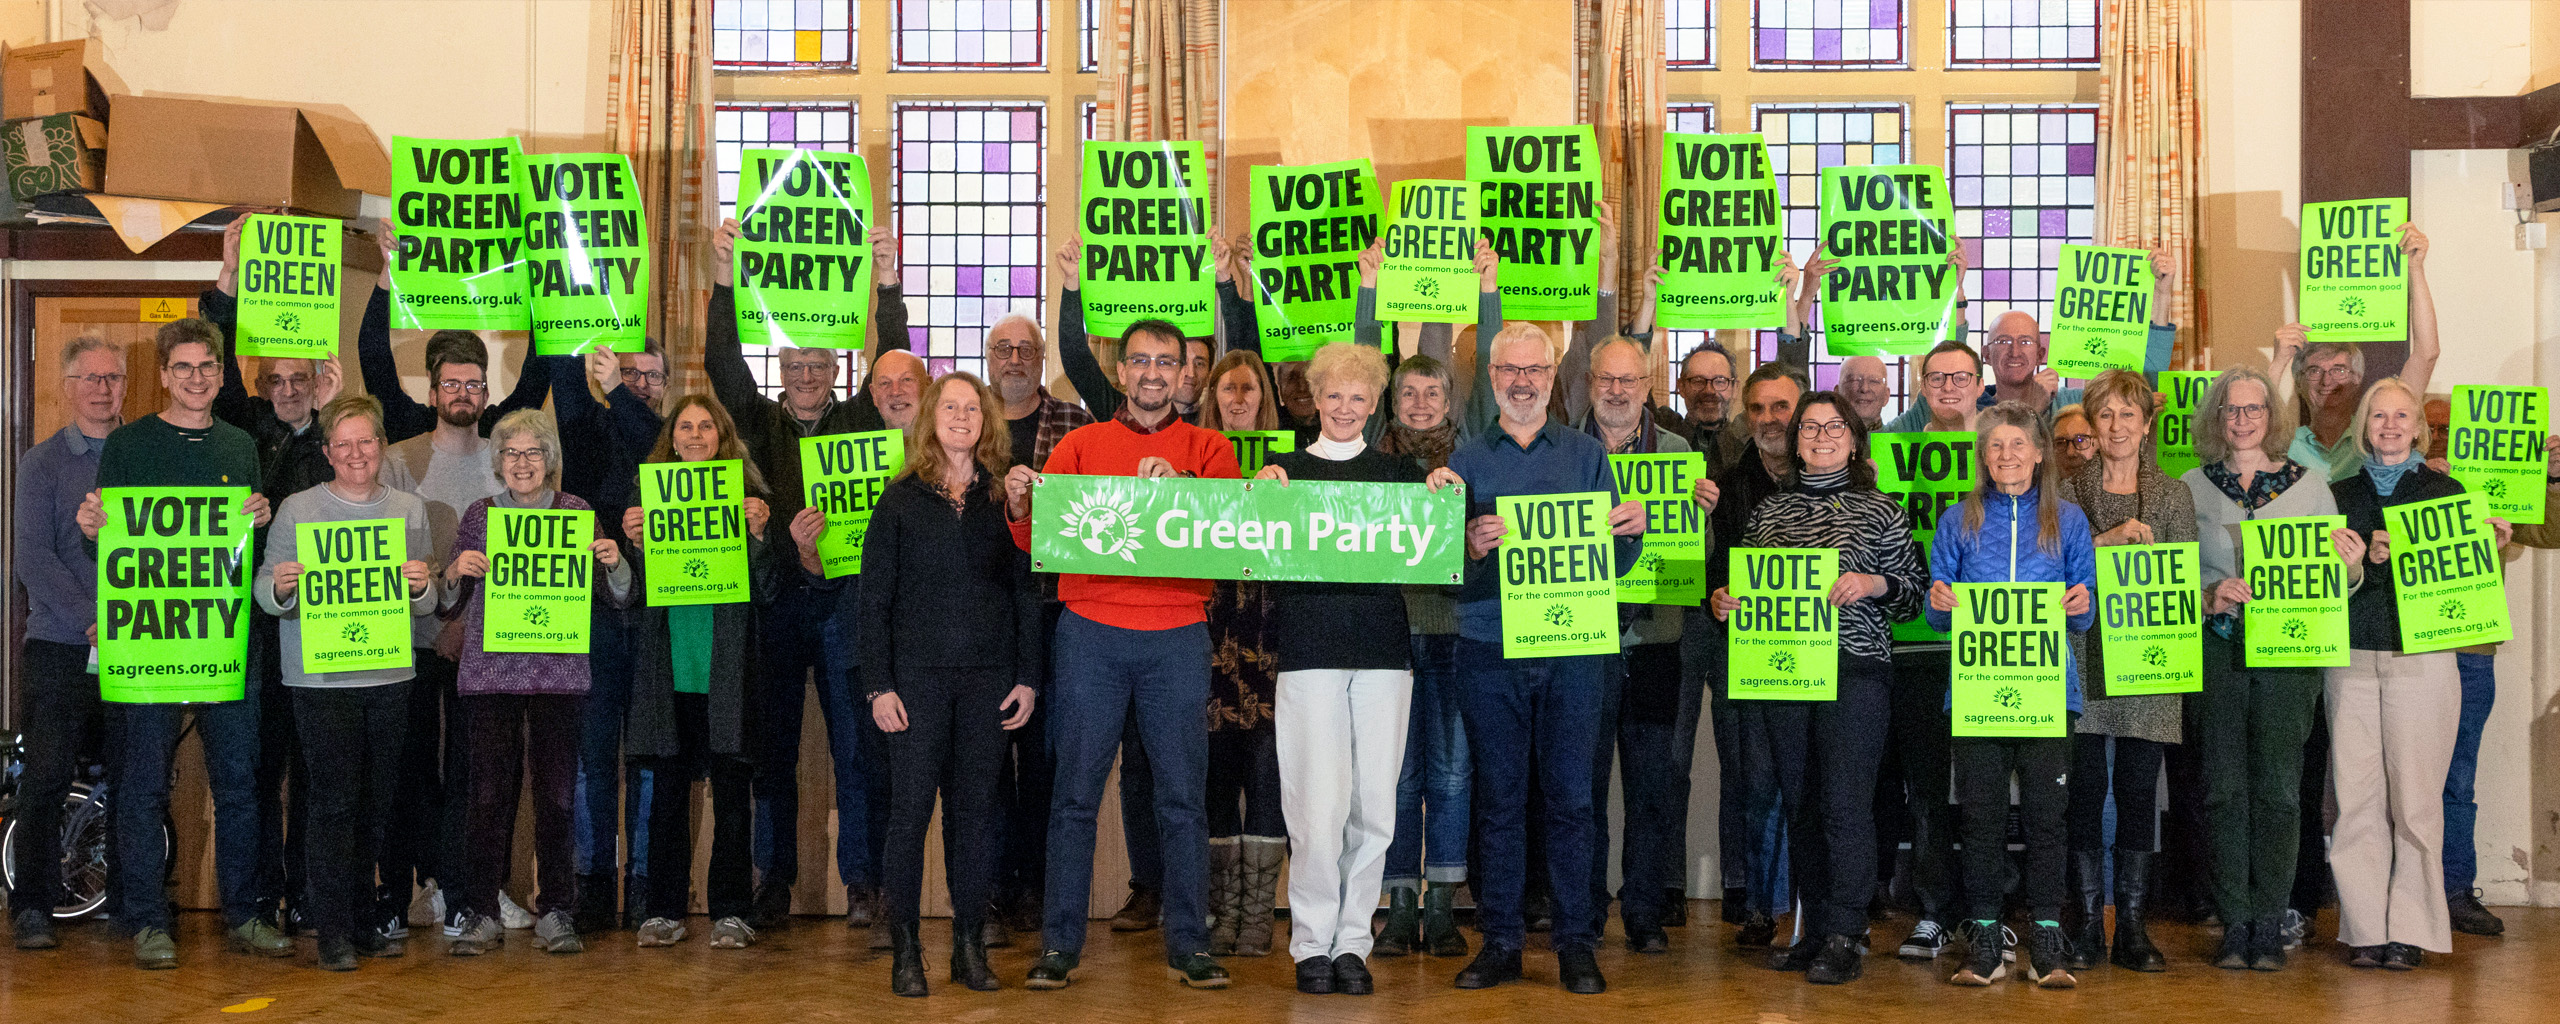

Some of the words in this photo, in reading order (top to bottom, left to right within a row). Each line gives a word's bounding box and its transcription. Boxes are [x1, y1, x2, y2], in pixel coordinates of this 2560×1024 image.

[412, 147, 509, 185] VOTE
[1098, 150, 1191, 188] VOTE
[1486, 135, 1581, 173] VOTE
[1676, 143, 1764, 181] VOTE
[528, 162, 624, 201] VOTE
[1268, 168, 1364, 212] VOTE
[1839, 174, 1933, 211] VOTE
[398, 191, 521, 229] GREEN
[1086, 198, 1205, 235] GREEN
[1400, 185, 1467, 221] VOTE
[1481, 181, 1592, 219] GREEN
[1664, 188, 1775, 227] GREEN
[257, 221, 326, 257] VOTE
[742, 206, 863, 245] GREEN
[1256, 213, 1378, 258] GREEN
[1828, 218, 1947, 257] GREEN
[2319, 204, 2391, 239] VOTE
[399, 235, 522, 273] PARTY
[1385, 224, 1475, 261] GREEN
[1662, 235, 1777, 273] PARTY
[245, 259, 335, 296] GREEN
[741, 251, 863, 292] PARTY
[1087, 245, 1206, 282] PARTY
[2075, 250, 2143, 287] VOTE
[2307, 244, 2401, 279] GREEN
[399, 293, 522, 307] sagreens.org.uk
[1498, 284, 1591, 299] reens.org.uk
[1661, 291, 1777, 307] sagreens.org.uk
[1829, 263, 1949, 302] PARTY
[2306, 284, 2321, 292] For
[2323, 284, 2337, 292] the
[2339, 284, 2376, 292] common
[2379, 283, 2402, 292] good
[314, 302, 334, 310] good
[535, 314, 641, 330] agreens.org.uk
[741, 310, 859, 326] sagreens.org.uk
[1089, 300, 1207, 315] sagreens.org.uk
[1387, 302, 1467, 313] sagreens.org.uk
[2059, 287, 2147, 324] GREEN
[248, 336, 328, 347] sagreens.org.uk
[1266, 321, 1355, 340] sagreens.or
[2311, 320, 2396, 331] sagreens.org.uk
[2468, 390, 2536, 425] VOTE
[816, 436, 889, 476] VOTE
[1891, 441, 1976, 481] VOT
[2454, 427, 2544, 462] GREEN
[656, 466, 728, 503] VOTE
[1616, 460, 1687, 495] VOTE
[2452, 465, 2467, 473] For
[2468, 465, 2482, 473] the
[2484, 466, 2519, 475] common
[2521, 467, 2542, 476] good
[811, 476, 891, 515] GREE
[2488, 503, 2533, 512] ns.org.uk
[122, 497, 228, 537] VOTE
[504, 514, 578, 549] VOTE
[650, 505, 740, 542] GREEN
[844, 517, 870, 525] comm
[1515, 499, 1595, 540] VOTE
[1646, 500, 1698, 534] EEN
[2400, 499, 2476, 545] VOTE
[314, 525, 391, 564] VOTE
[682, 545, 718, 554] common
[720, 544, 741, 553] good
[1155, 510, 1292, 551] Green
[1308, 512, 1436, 566] Party
[1679, 540, 1699, 548] good
[2258, 522, 2330, 559] VOTE
[106, 547, 242, 589] GREEN
[492, 552, 586, 588] GREEN
[1506, 544, 1609, 586] GREEN
[1746, 554, 1821, 590] VOTE
[2112, 549, 2186, 587] VOTE
[2398, 538, 2494, 587] GREEN
[305, 565, 402, 606] GREEN
[492, 592, 506, 600] For
[508, 592, 522, 600] the
[564, 594, 586, 603] good
[657, 581, 738, 595] sagreens.org.uk
[1508, 592, 1523, 601] For
[1526, 591, 1541, 600] the
[1543, 589, 1584, 599] common
[1586, 588, 1610, 598] good
[2250, 563, 2341, 601] GREEN
[2403, 593, 2418, 601] For
[2420, 590, 2434, 599] the
[2436, 584, 2474, 597] common
[2476, 580, 2497, 592] good
[107, 599, 244, 640] PARTY
[306, 612, 322, 620] For
[324, 611, 338, 619] the
[340, 609, 381, 618] common
[383, 607, 404, 618] good
[1735, 595, 1832, 632] GREEN
[1969, 588, 2048, 625] VOTE
[2106, 590, 2196, 628] GREEN
[2320, 604, 2342, 614] good
[495, 631, 579, 642] sagreens.org.uk
[1516, 630, 1607, 645] sagreens.org.uk
[1735, 637, 1750, 645] For
[1752, 637, 1766, 645] the
[1768, 638, 1807, 646] common
[1809, 638, 1832, 647] good
[2141, 632, 2176, 641] common
[2178, 631, 2197, 641] good
[2414, 619, 2499, 640] sagreens.org.uk
[314, 646, 400, 661] sagreens.org.uk
[1959, 630, 2059, 668] GREEN
[2256, 644, 2337, 655] sagreens.org.uk
[108, 660, 241, 678] sagreens.org.uk
[1740, 677, 1826, 688] sagreens.org.uk
[1959, 673, 1974, 681] For
[1976, 673, 1991, 681] the
[2036, 674, 2059, 683] good
[2116, 670, 2193, 683] sagreens.org.uk
[1964, 713, 2054, 724] sagreens.org.uk
